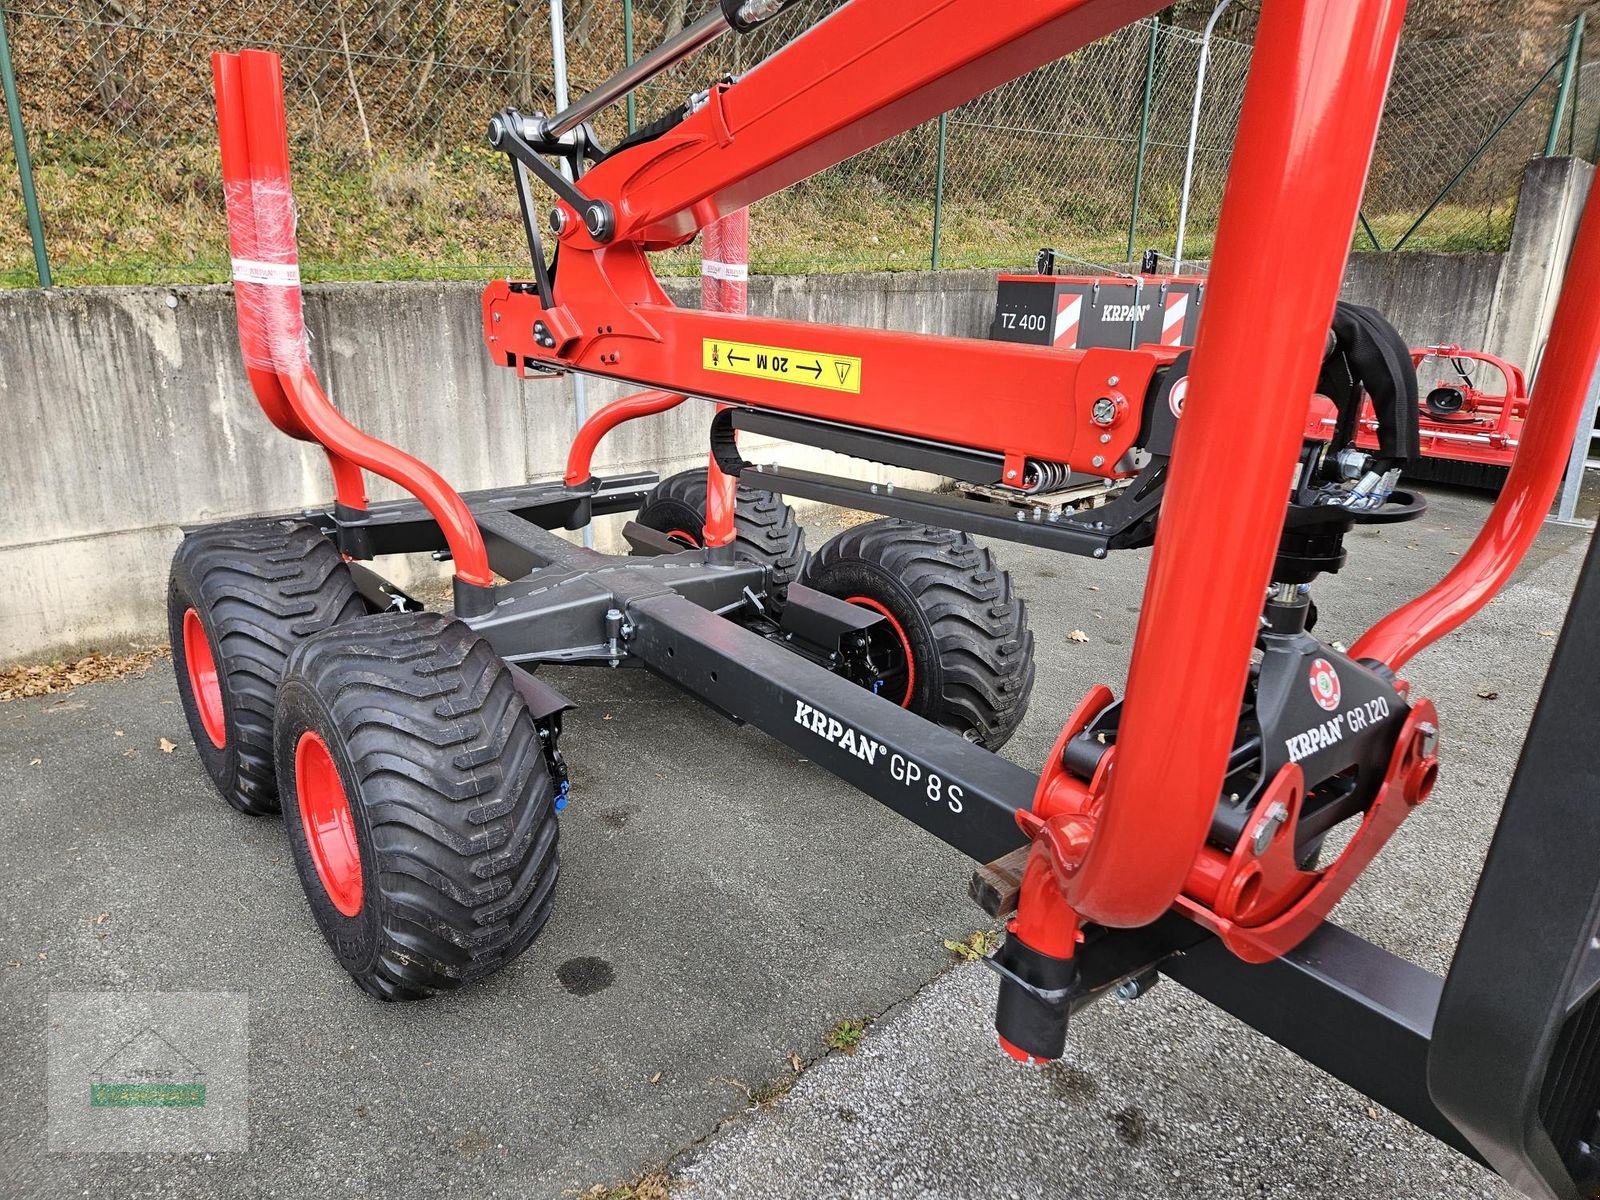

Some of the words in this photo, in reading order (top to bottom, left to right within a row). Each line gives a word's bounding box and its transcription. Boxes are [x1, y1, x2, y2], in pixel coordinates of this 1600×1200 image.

[1001, 313, 1016, 329] TZ
[1019, 314, 1047, 331] 400
[757, 353, 768, 370] M
[772, 356, 789, 373] 20
[1346, 706, 1368, 733] GR
[1364, 696, 1390, 724] 120
[890, 753, 922, 786] GP
[926, 773, 942, 802] 8
[947, 784, 964, 814] S
